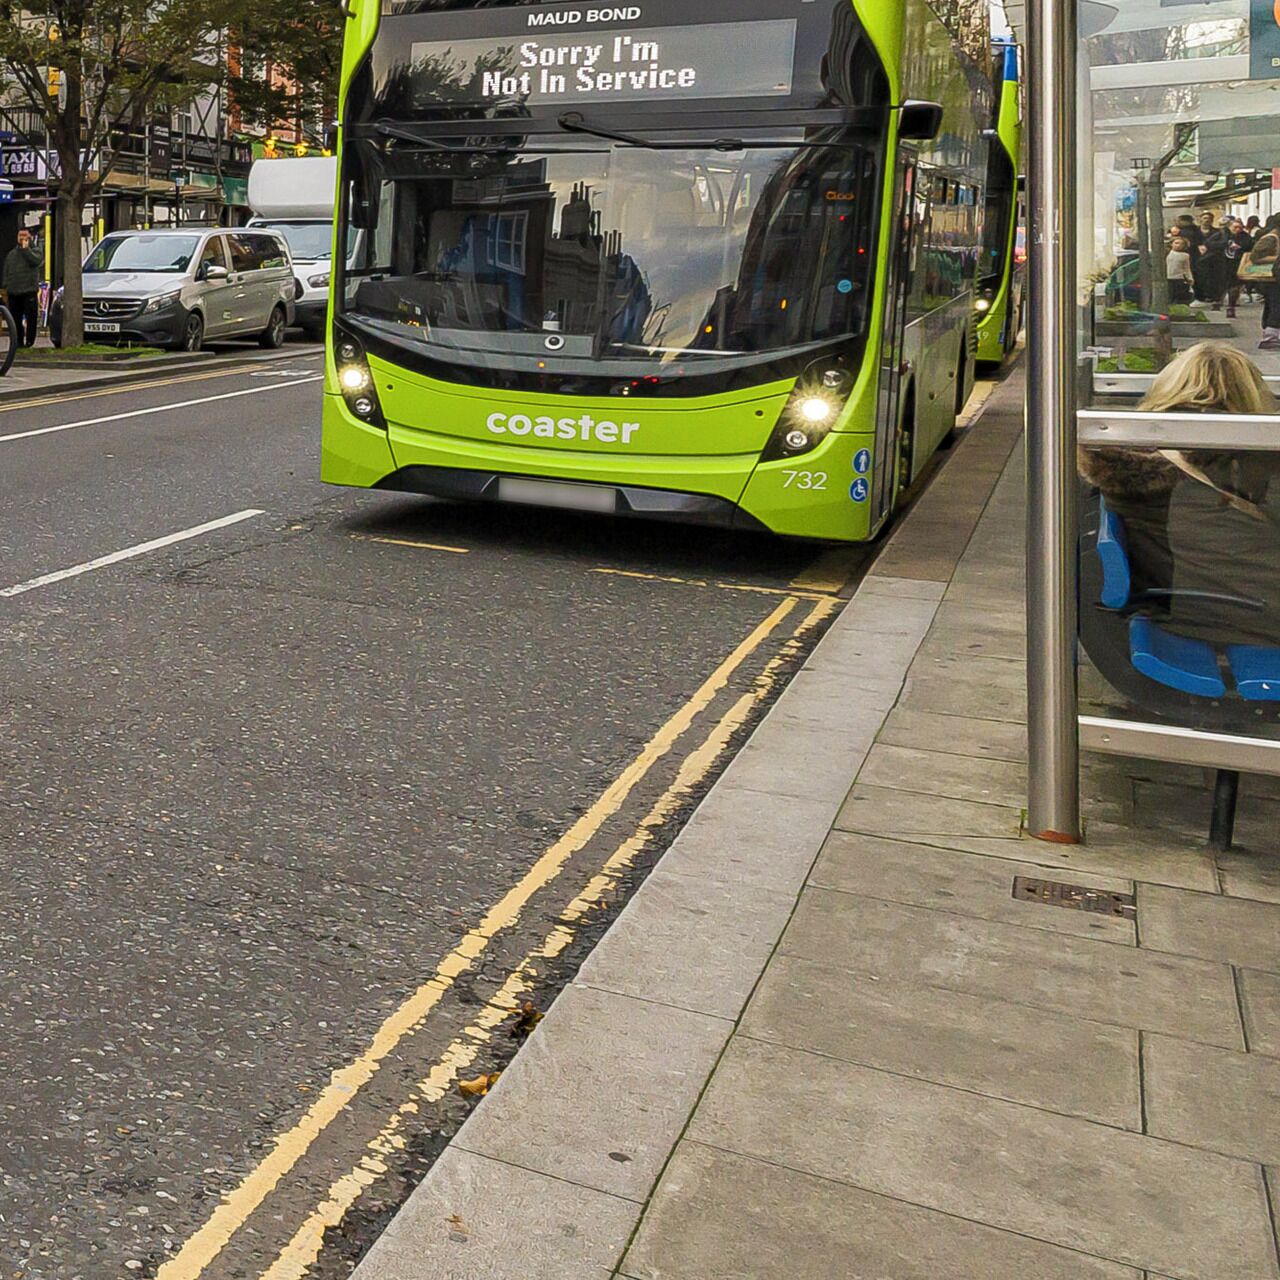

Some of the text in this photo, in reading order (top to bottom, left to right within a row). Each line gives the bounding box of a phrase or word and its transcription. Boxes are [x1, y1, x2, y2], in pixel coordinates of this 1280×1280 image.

[527, 7, 641, 26] MAUD BOND
[520, 36, 659, 67] Sorry I'm
[482, 64, 696, 97] Not In Service
[2, 152, 35, 165] TAXI
[486, 412, 640, 444] coaster
[781, 470, 828, 490] 732
